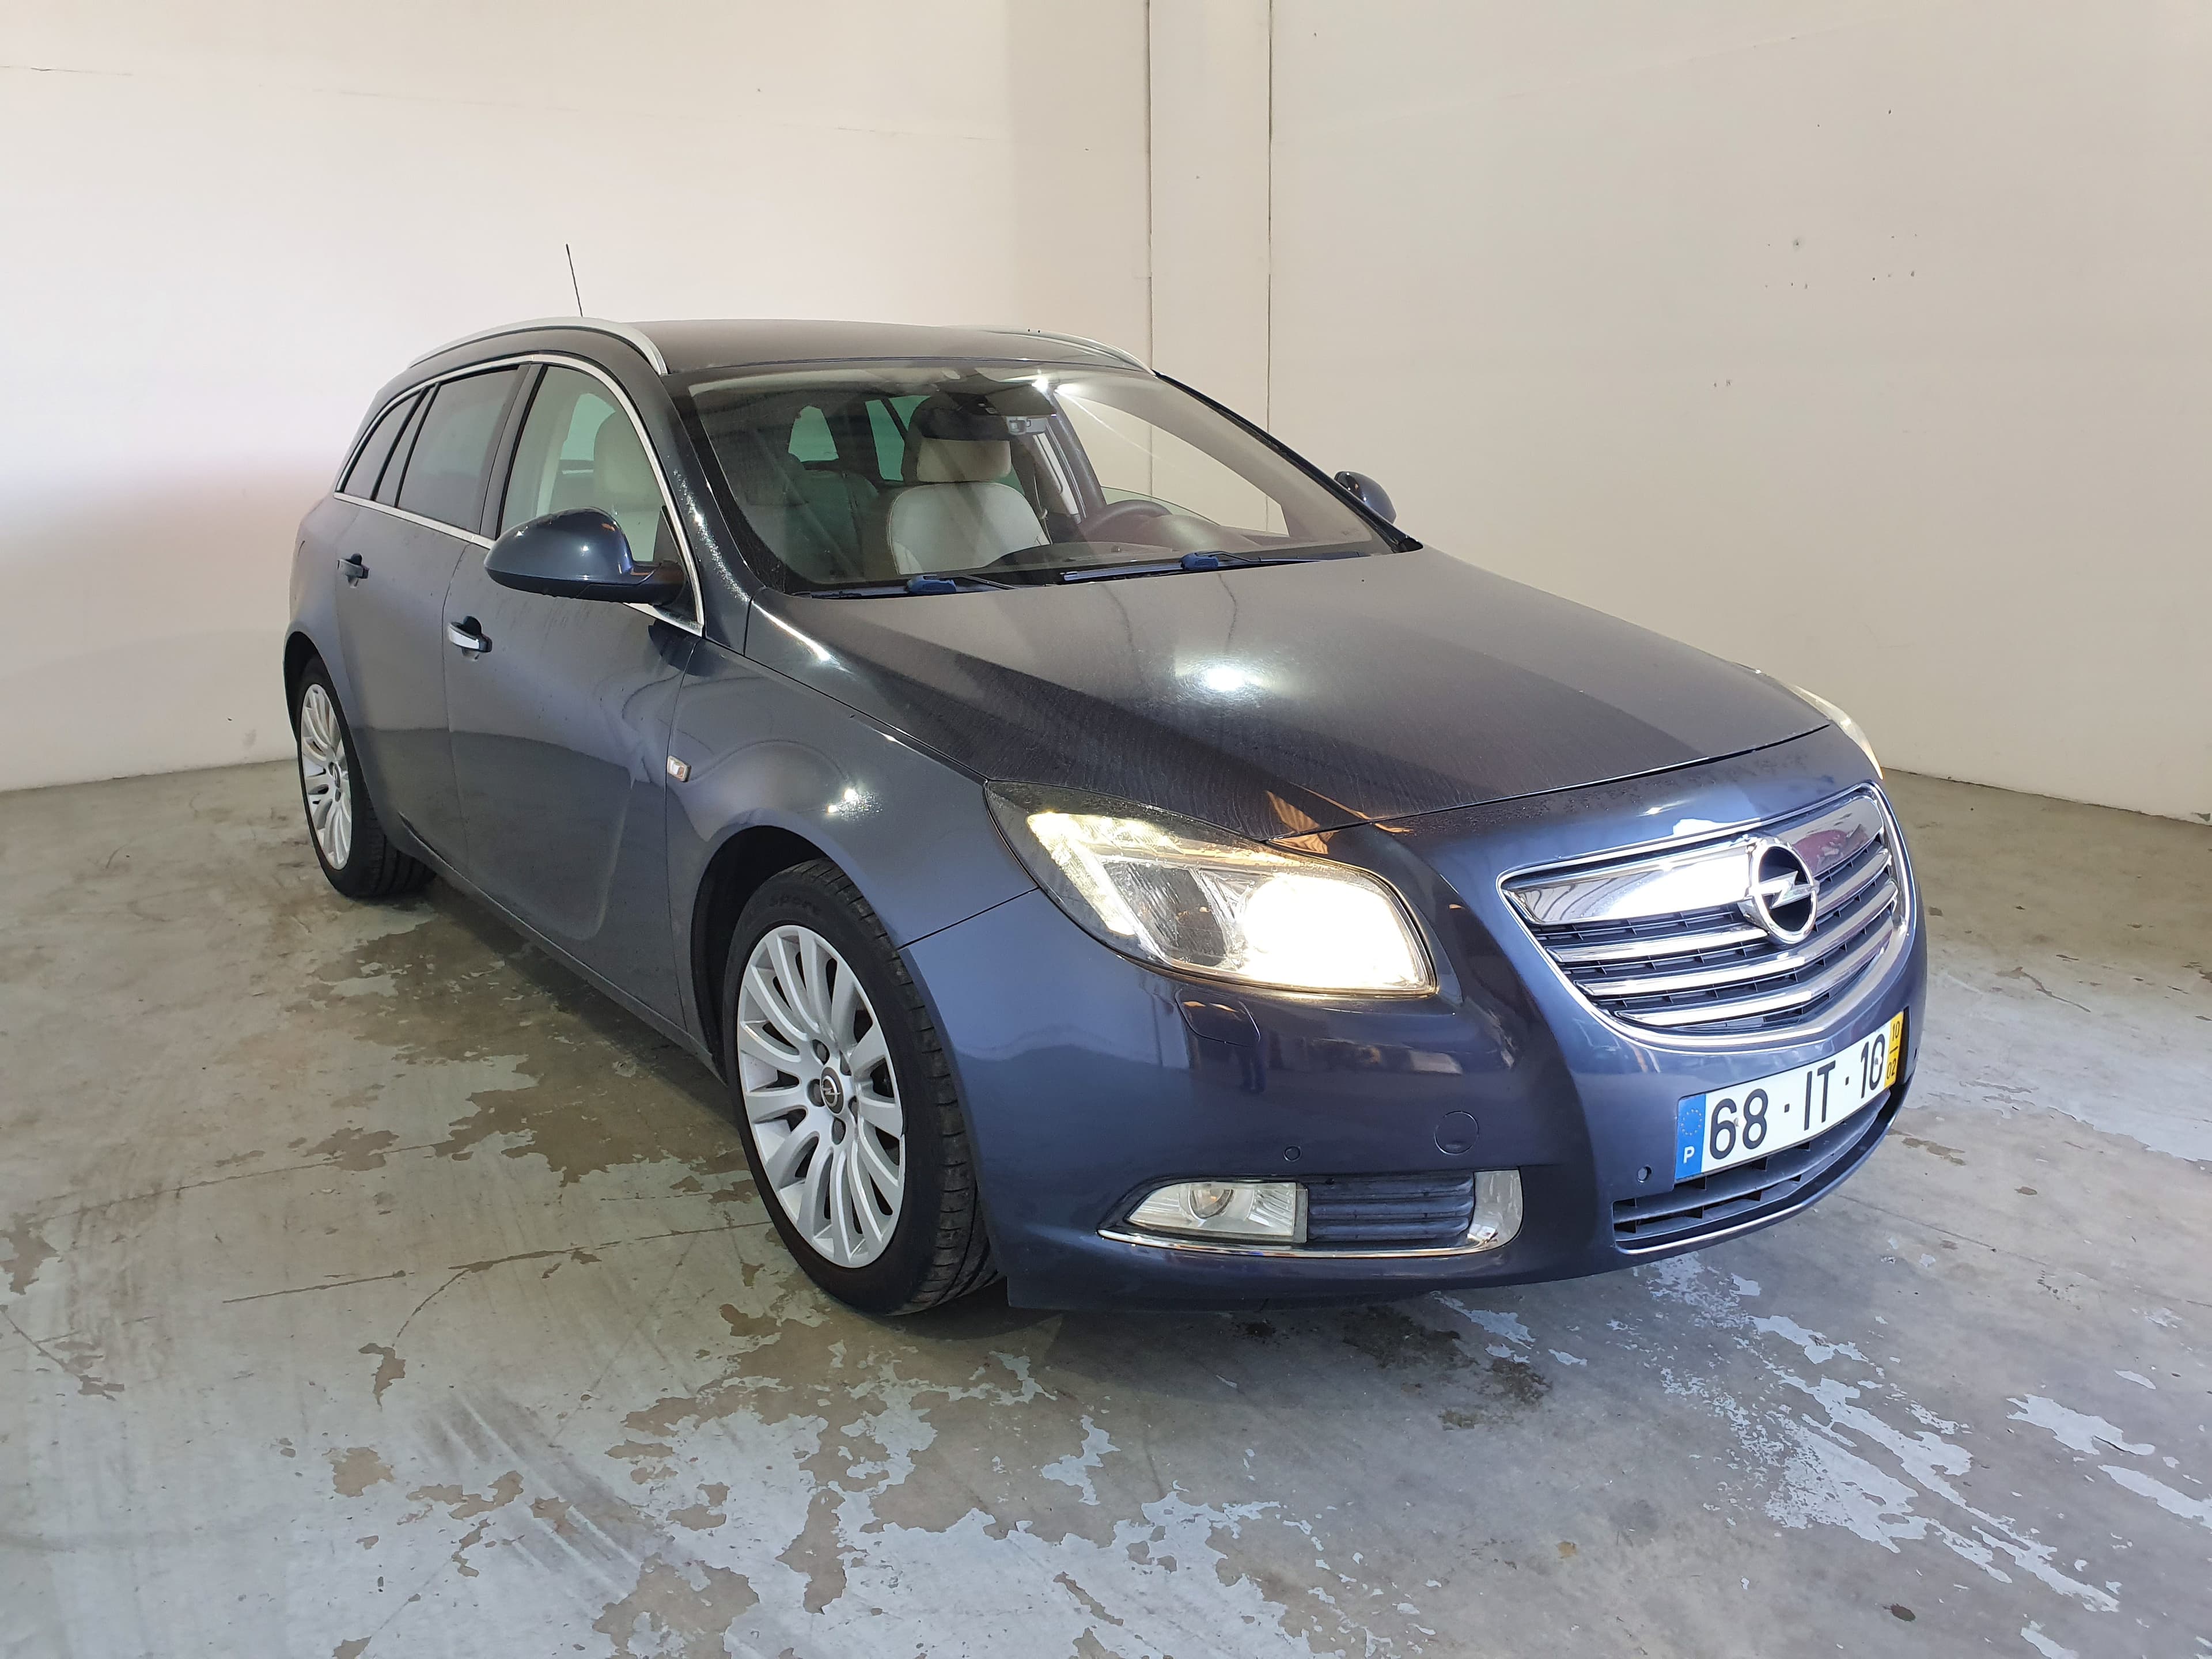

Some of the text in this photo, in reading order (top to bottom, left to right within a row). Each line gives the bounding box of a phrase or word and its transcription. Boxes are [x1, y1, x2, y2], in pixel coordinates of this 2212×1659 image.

[1892, 1021, 1900, 1041] 10
[1887, 1058, 1896, 1080] 02
[1683, 1146, 1695, 1164] P
